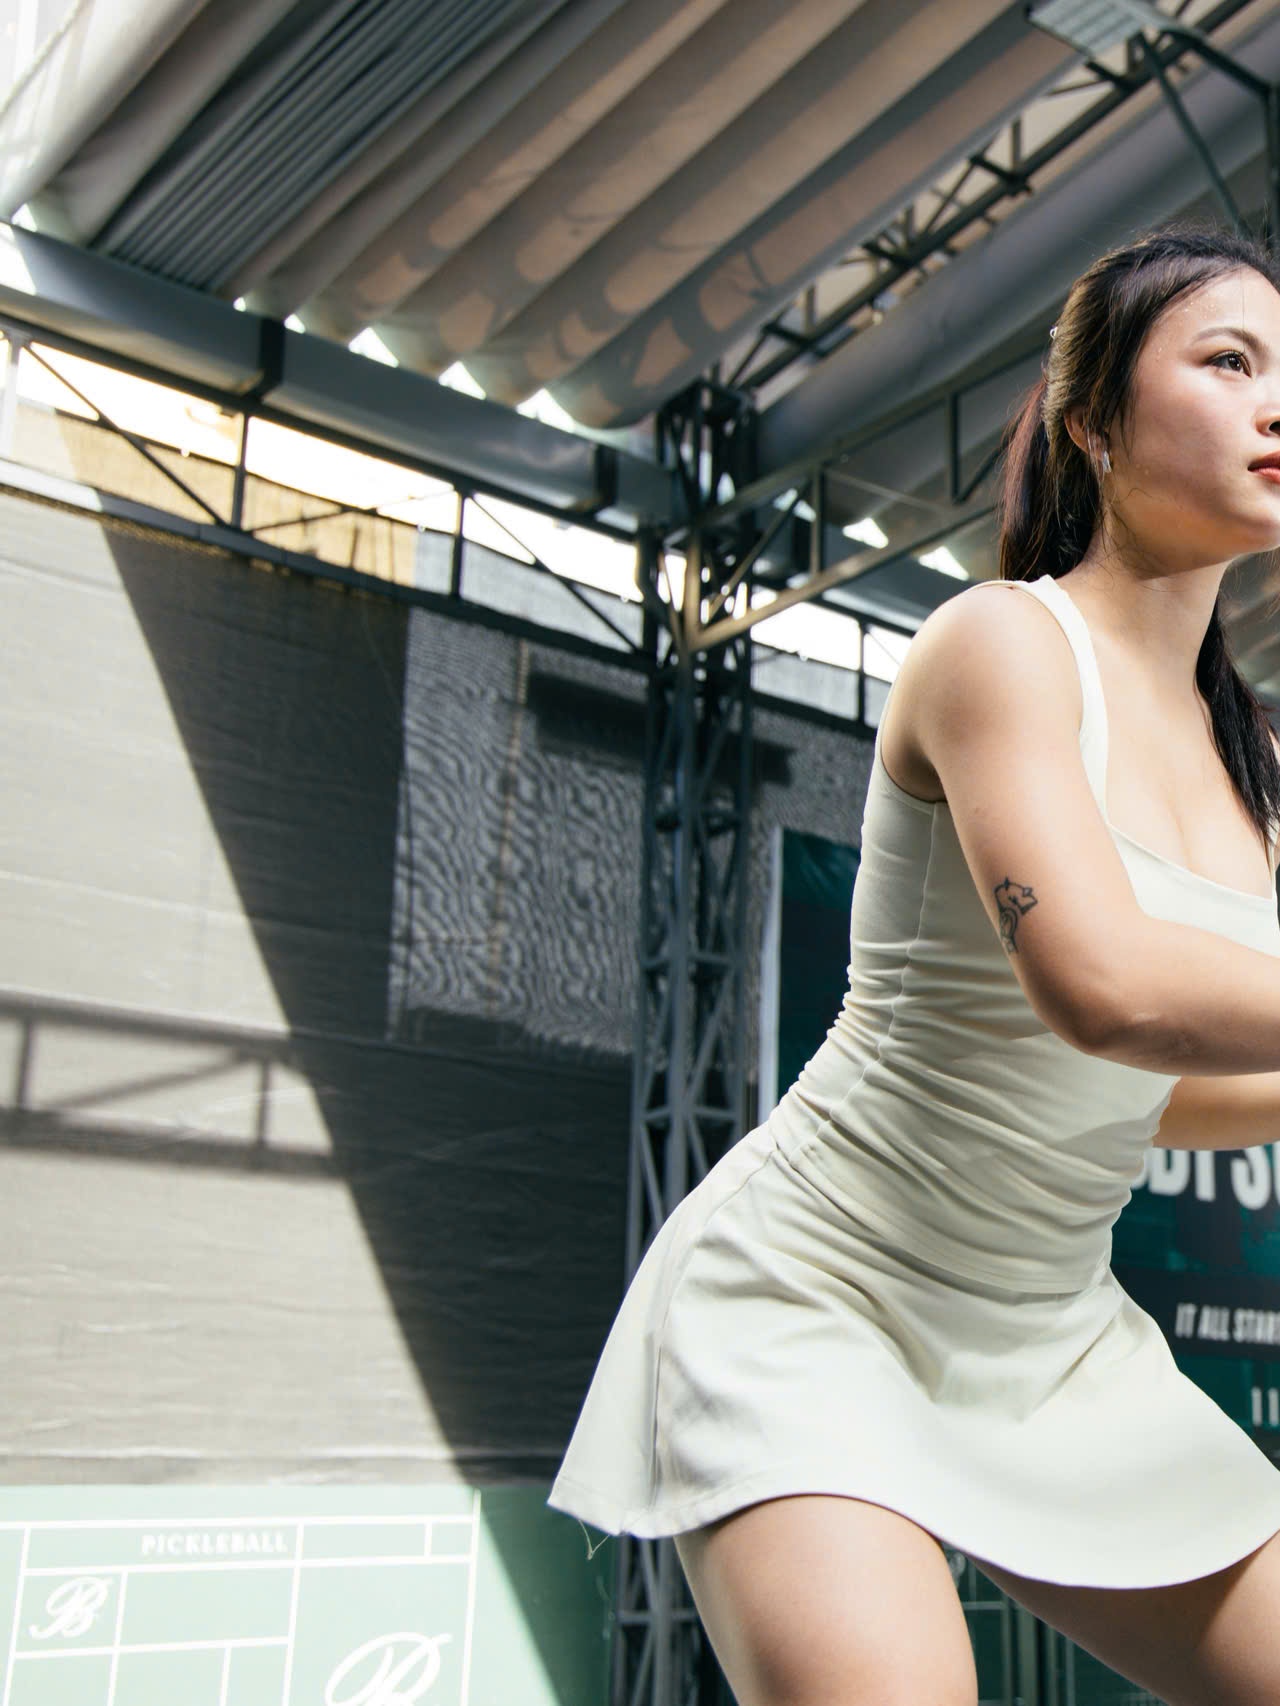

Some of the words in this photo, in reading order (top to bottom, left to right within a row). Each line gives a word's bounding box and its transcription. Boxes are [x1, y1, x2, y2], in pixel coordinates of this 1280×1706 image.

[1175, 1302, 1196, 1339] IT
[1198, 1304, 1231, 1341] ALL
[140, 1530, 289, 1556] PICKLEBALL
